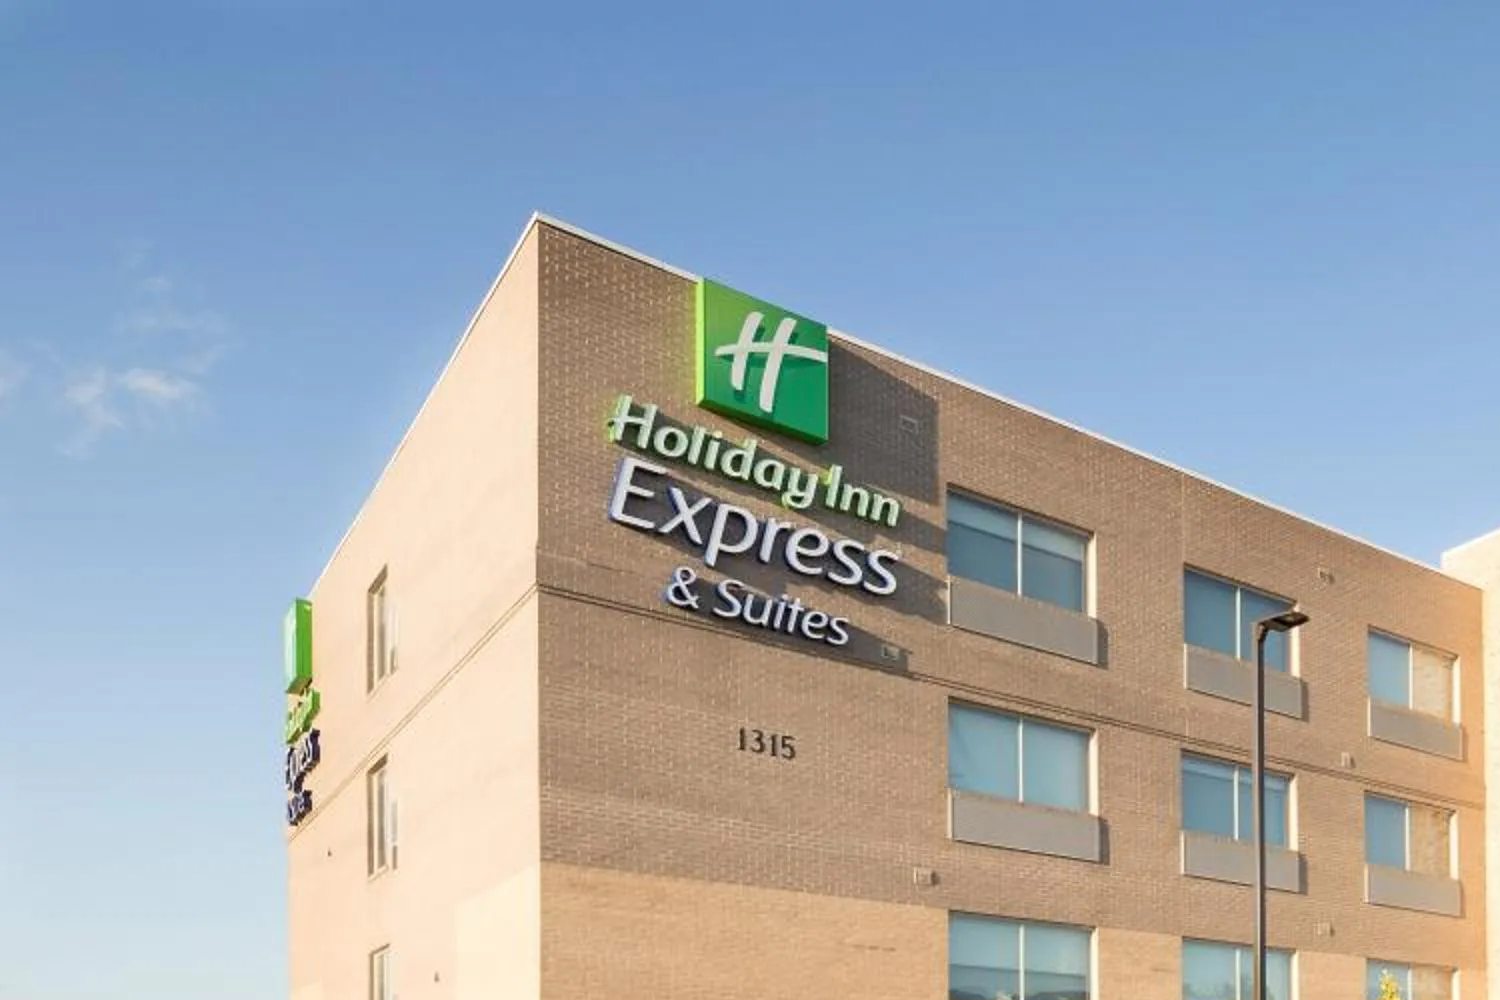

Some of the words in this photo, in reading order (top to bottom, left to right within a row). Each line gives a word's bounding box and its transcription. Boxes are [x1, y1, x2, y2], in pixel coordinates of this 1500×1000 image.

[714, 310, 827, 413] H
[607, 395, 817, 510] Holiday
[825, 464, 900, 527] Inn
[608, 456, 900, 596] Express
[666, 566, 700, 611] &
[713, 578, 849, 646] Suites
[737, 726, 797, 761] 1315
